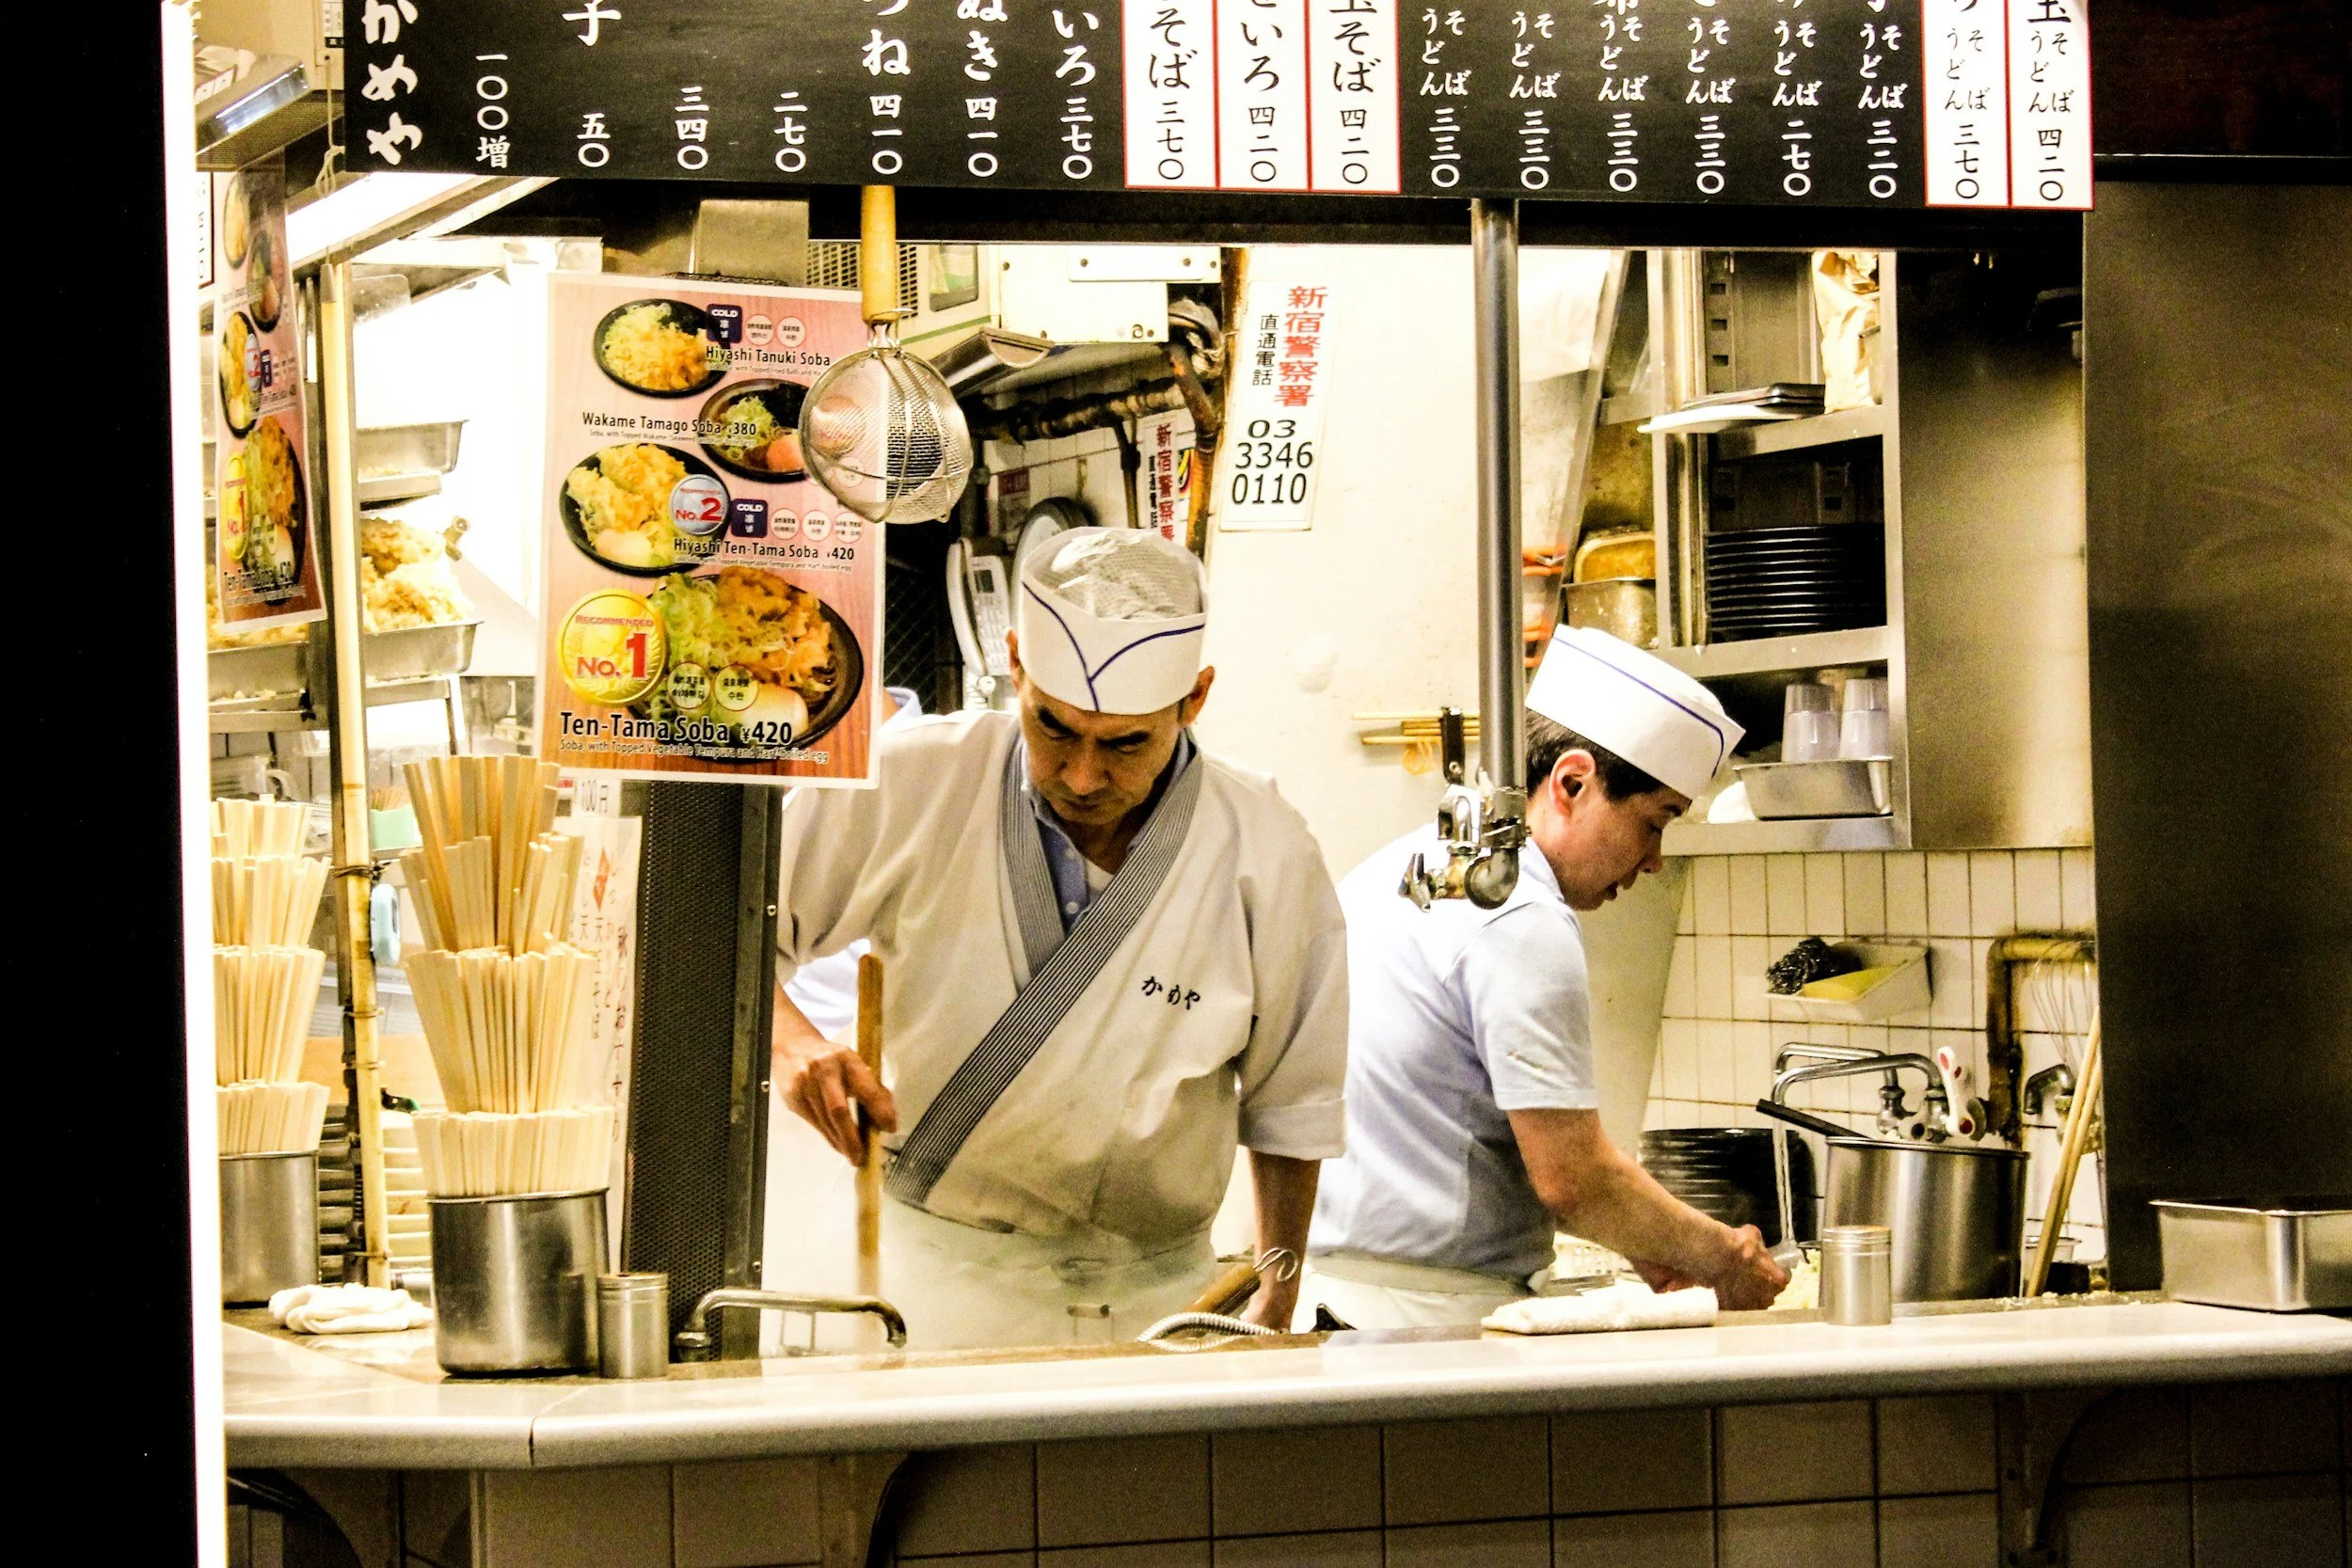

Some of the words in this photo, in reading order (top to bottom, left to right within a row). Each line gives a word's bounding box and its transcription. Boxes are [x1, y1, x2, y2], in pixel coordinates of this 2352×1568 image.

[1242, 0, 1281, 90] いろ
[362, 0, 421, 165] かめや
[675, 87, 709, 169] 三四〇
[773, 92, 807, 172] 二七〇
[869, 95, 902, 174] 四一〇
[965, 97, 998, 177] 四一〇
[1060, 97, 1093, 179] 三七〇
[1157, 102, 1184, 180] 三七〇
[1249, 107, 1277, 182] 四二〇
[1341, 109, 1369, 183] 四二〇
[711, 309, 739, 318] COLD
[1252, 314, 1279, 386] 直通電話
[1275, 285, 1328, 407] 新宿警察署
[706, 345, 752, 361] Hiyashi
[755, 349, 796, 364] Tanuki
[801, 352, 831, 366] Soba
[582, 412, 635, 428] Wakame
[641, 416, 688, 434] Tamago
[691, 419, 721, 434] Soba
[1235, 441, 1313, 469] 3346
[1248, 420, 1296, 438] 03
[737, 503, 763, 512] COLD
[1232, 473, 1307, 504] 0110
[674, 538, 721, 555] Hiyashi
[724, 541, 786, 557] Ten-Tama
[789, 545, 818, 559] Soba
[561, 712, 669, 739] Ten-Tama
[675, 716, 729, 742] Soba
[741, 721, 792, 744] ¥420
[1141, 975, 1200, 1011] かめや
